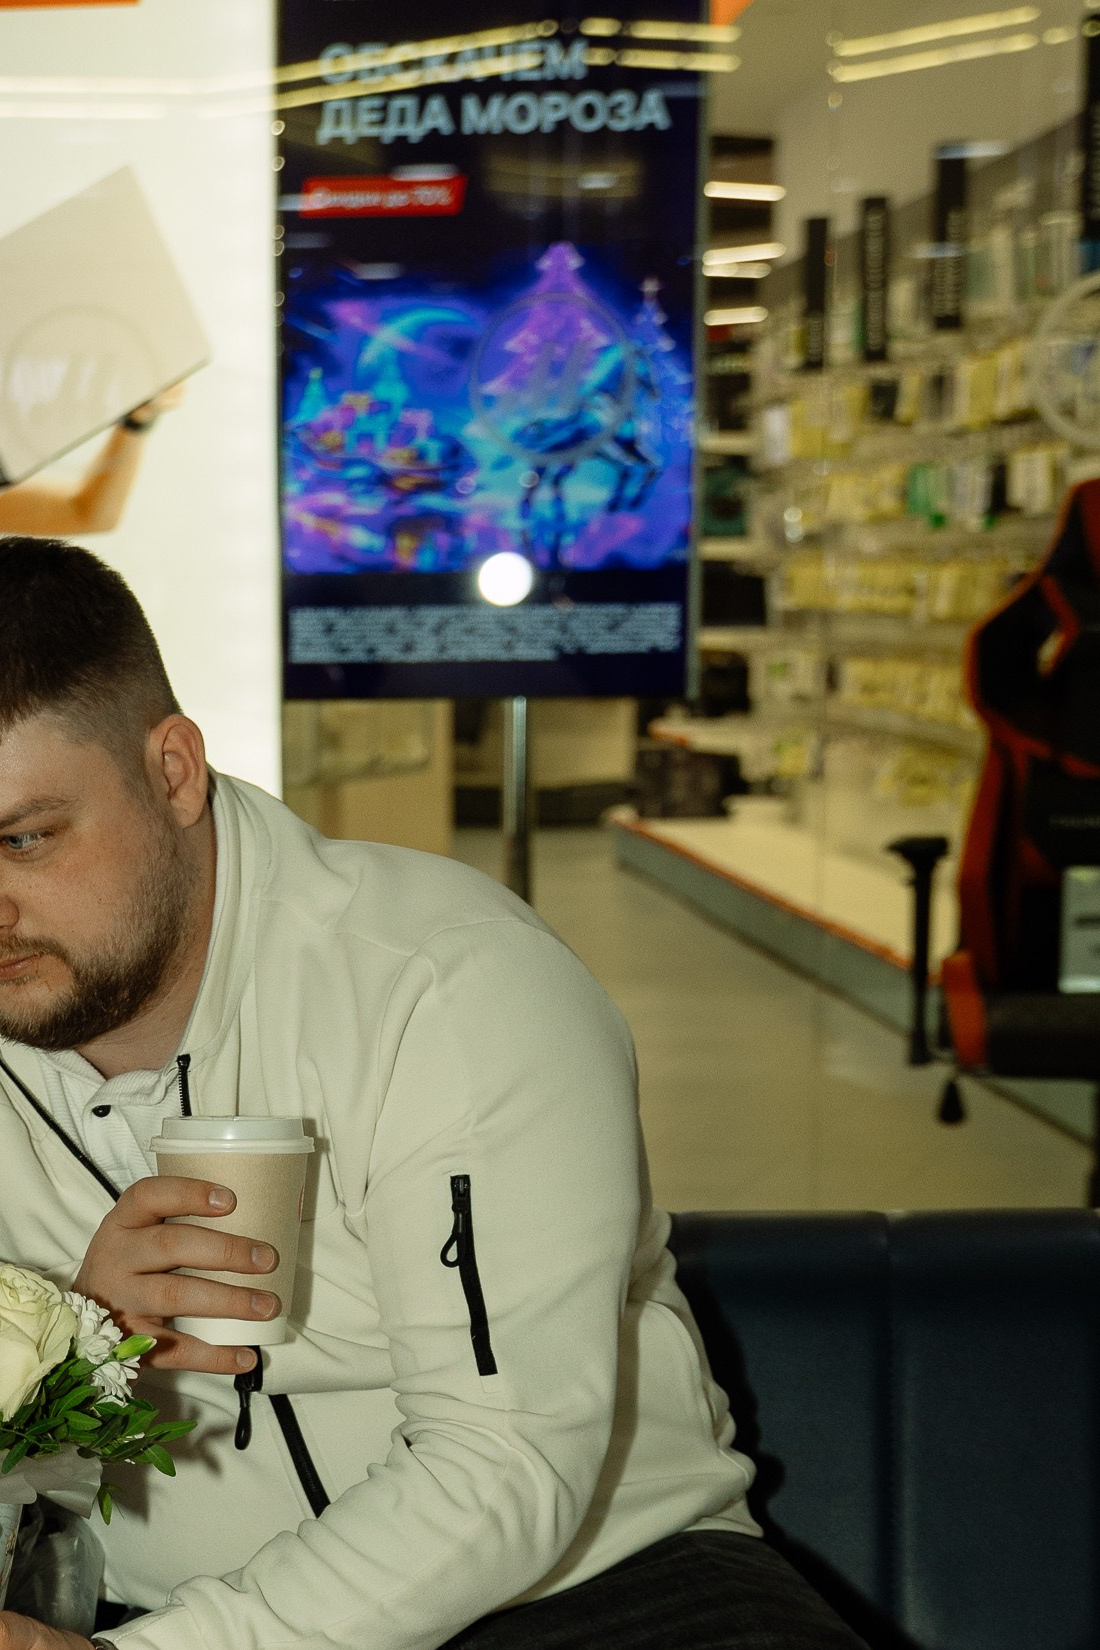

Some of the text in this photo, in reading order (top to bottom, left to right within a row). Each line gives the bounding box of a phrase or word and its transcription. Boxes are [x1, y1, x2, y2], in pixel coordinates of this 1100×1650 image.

[317, 38, 590, 84] ОБСКАЧЕМ
[316, 88, 673, 145] ДЕДА МОРОЗА
